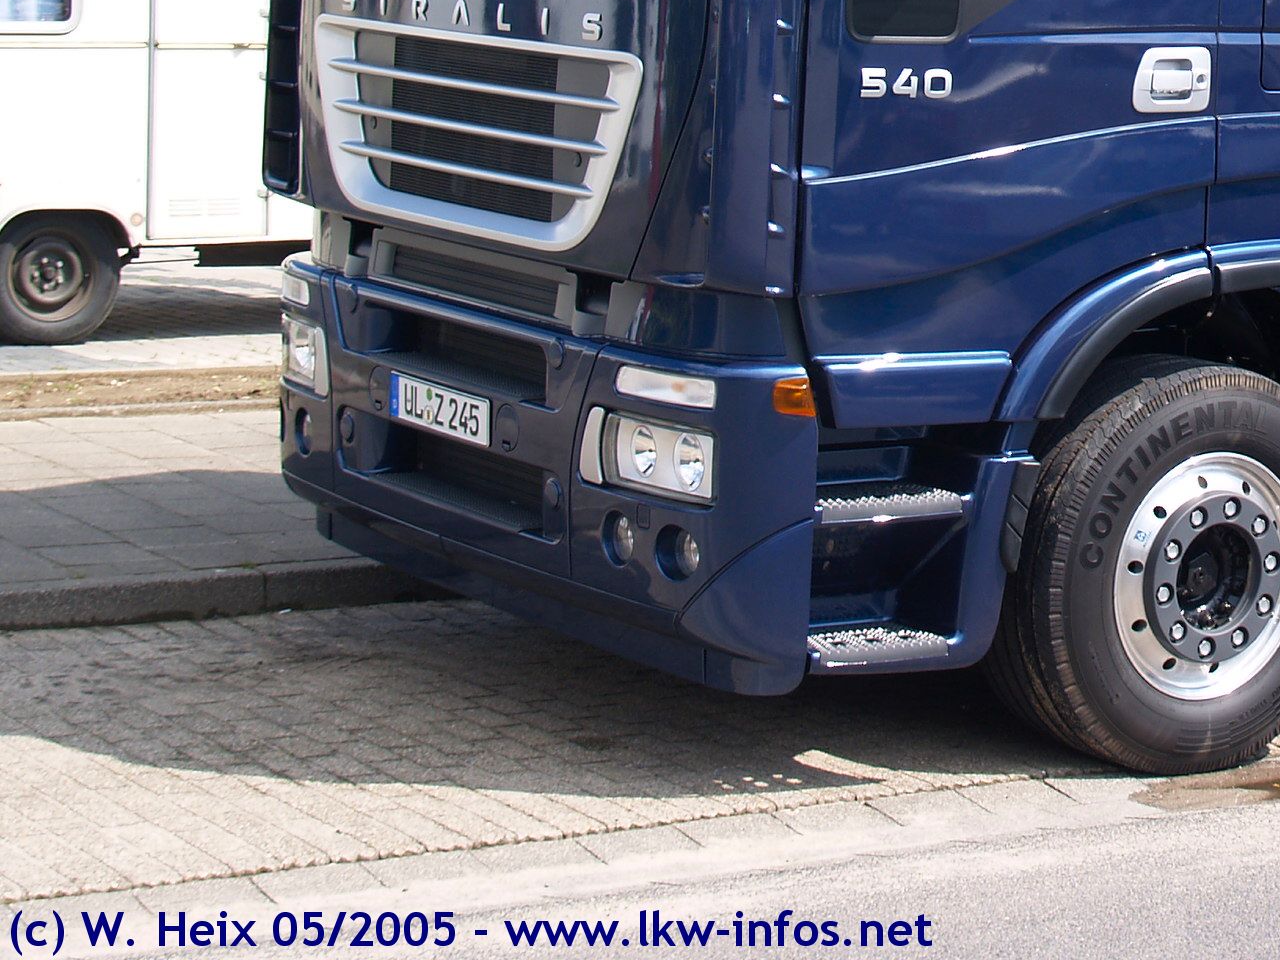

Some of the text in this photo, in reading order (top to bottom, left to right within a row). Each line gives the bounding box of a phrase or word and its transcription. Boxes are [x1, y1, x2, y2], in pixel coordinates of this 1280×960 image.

[860, 67, 953, 99] 540
[448, 398, 480, 437] 245
[1079, 400, 1269, 570] CONTINENTAL
